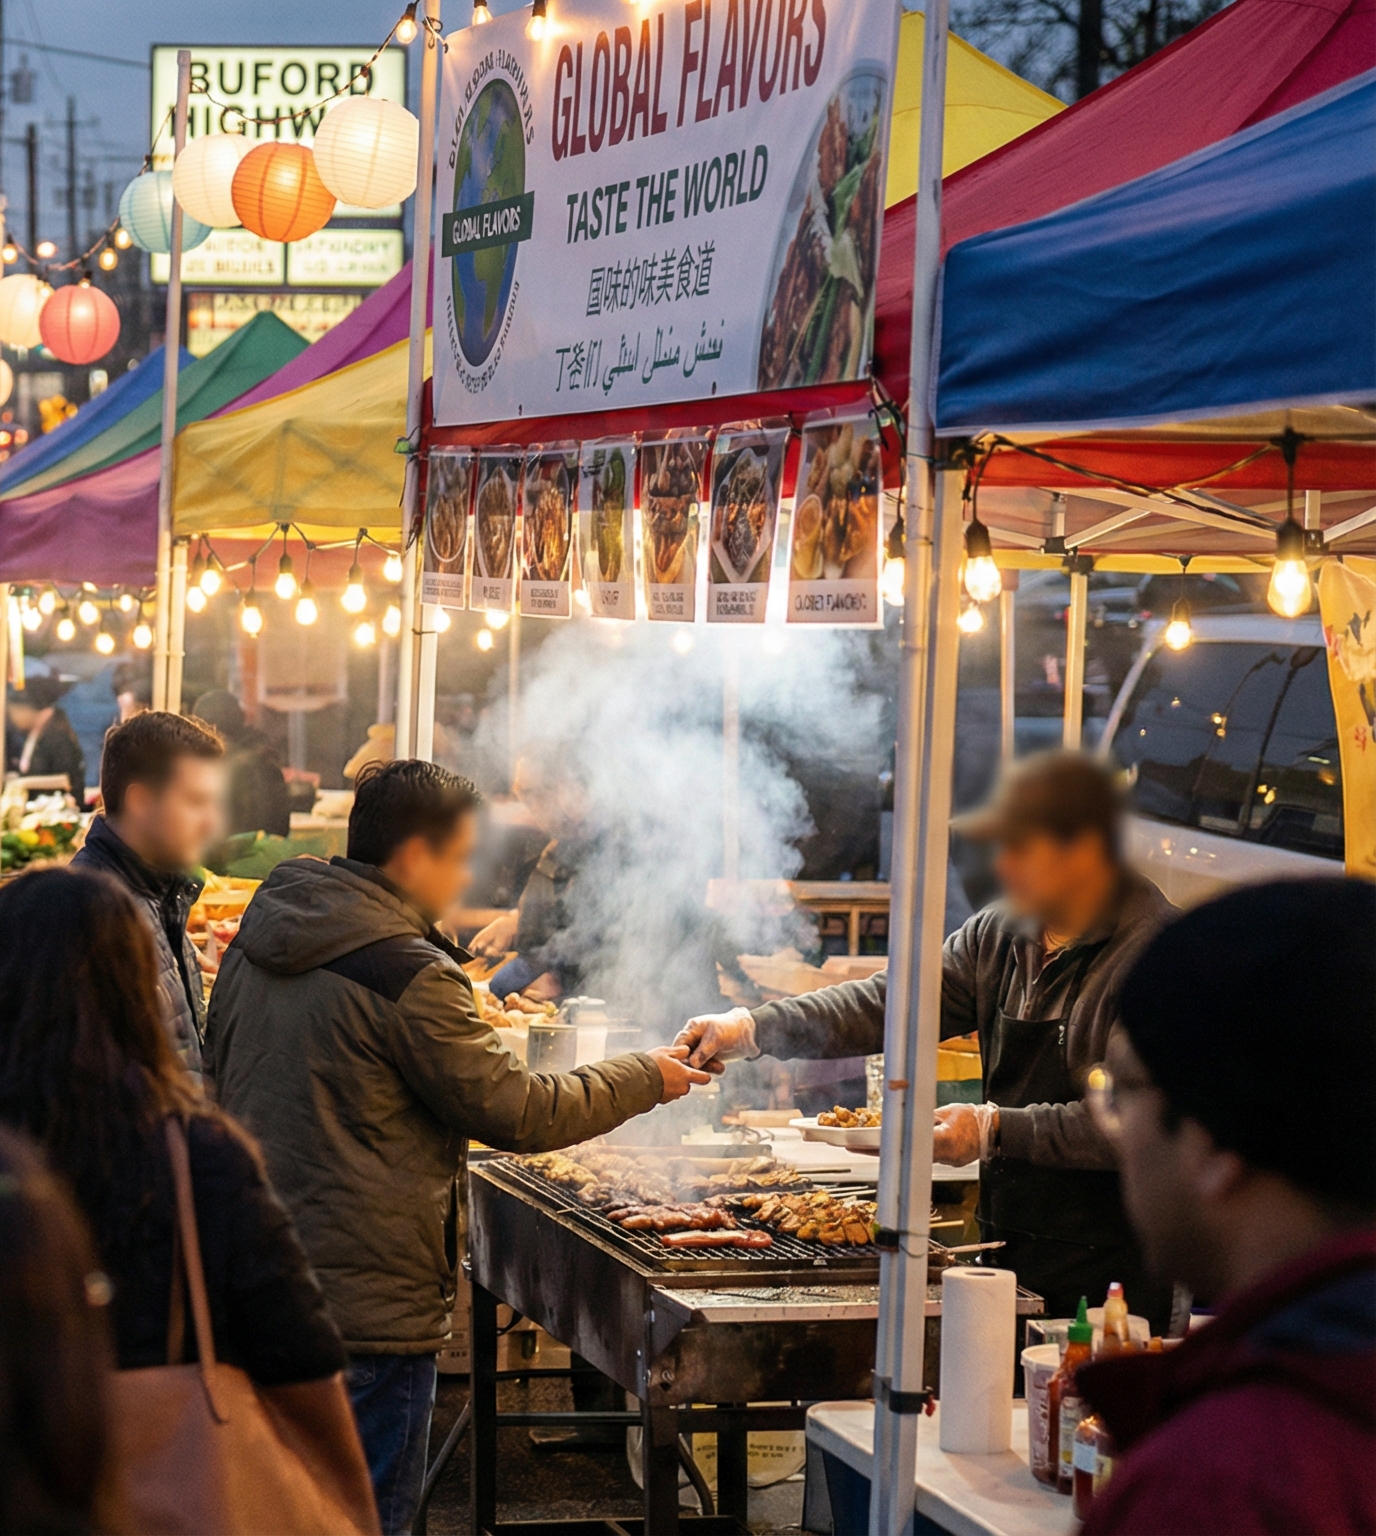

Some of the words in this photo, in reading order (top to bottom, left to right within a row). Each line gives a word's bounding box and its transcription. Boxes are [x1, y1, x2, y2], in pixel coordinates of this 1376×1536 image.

[189, 62, 374, 96] BUFORD
[552, 13, 668, 162] GLOBAL
[676, 0, 827, 128] FLAVORS
[567, 180, 631, 244] TASTE
[636, 168, 679, 229] THE
[684, 145, 769, 219] WORLD
